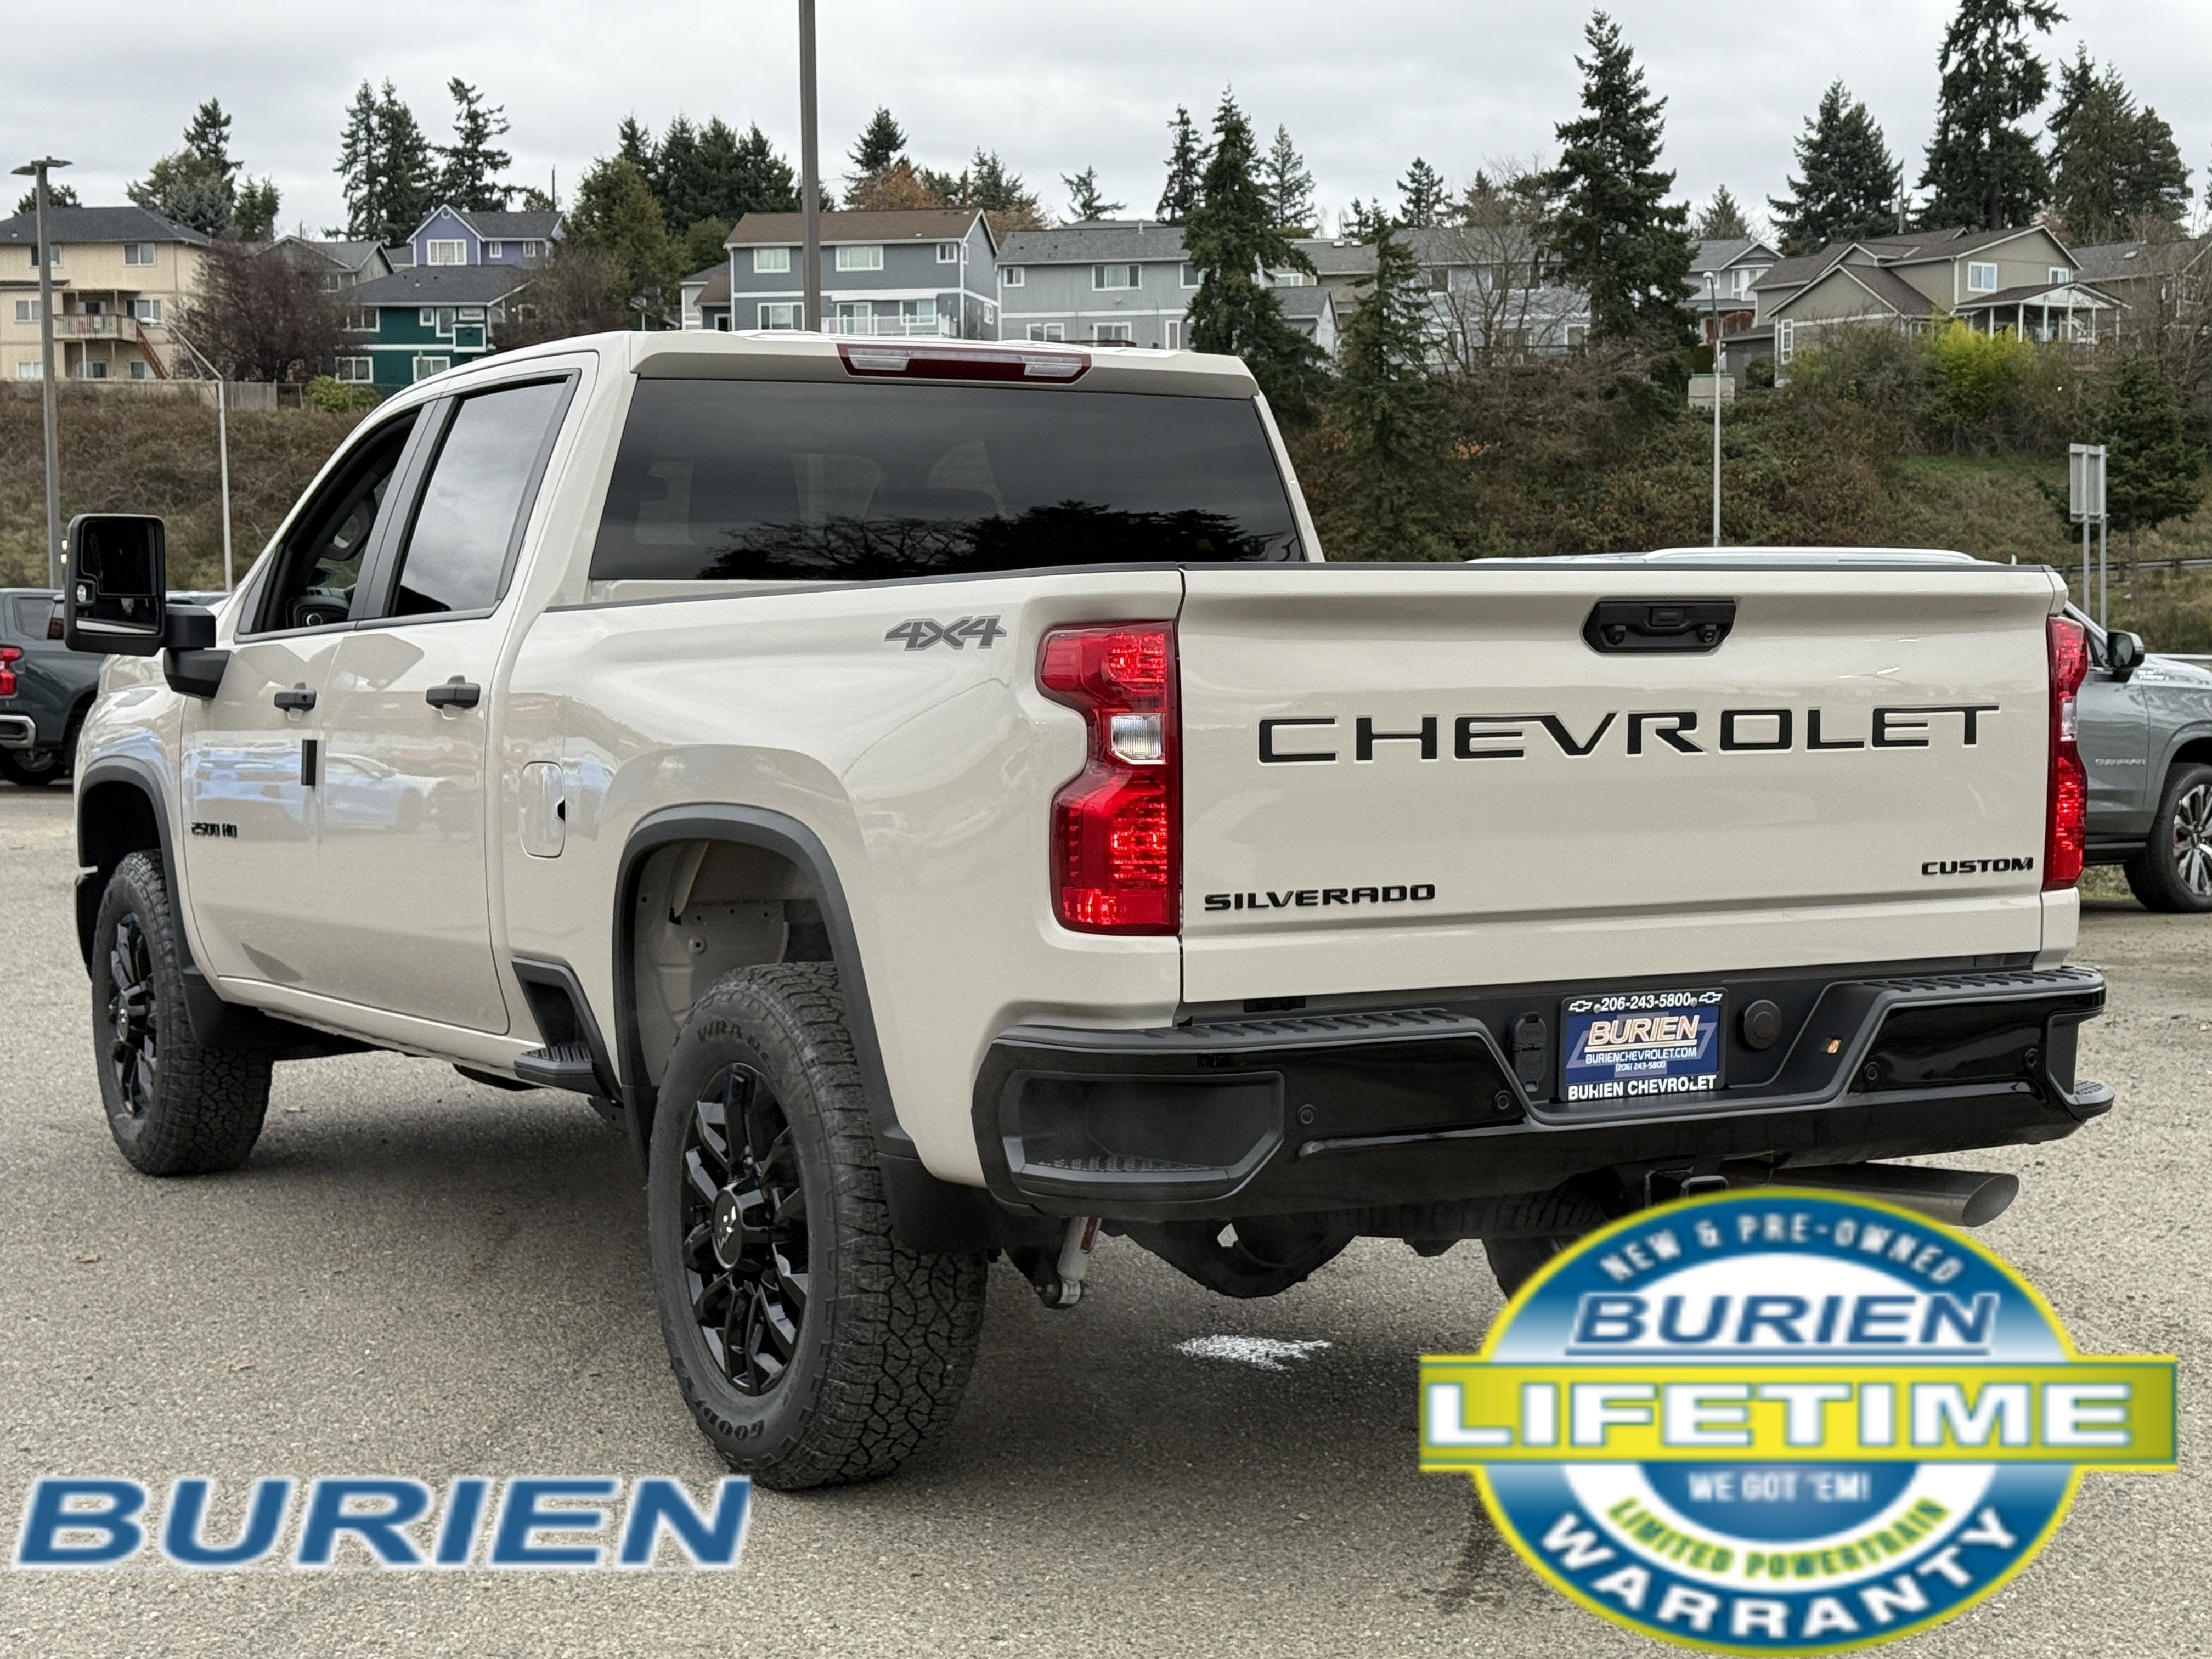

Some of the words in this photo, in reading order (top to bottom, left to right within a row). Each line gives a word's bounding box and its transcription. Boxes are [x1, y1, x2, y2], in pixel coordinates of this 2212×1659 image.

[1259, 704, 2000, 764] CHEVROLET
[1922, 857, 2034, 876] CUSTOM
[1204, 884, 1435, 911] SILVERADO
[1601, 992, 1691, 1012] 206-243-5800
[1588, 1015, 1700, 1046] BURIEN
[1585, 1047, 1697, 1065] BURIENCHEVROLET.COM
[1568, 1081, 1624, 1101] BURIEN
[1627, 1074, 1717, 1096] CHEVROLET
